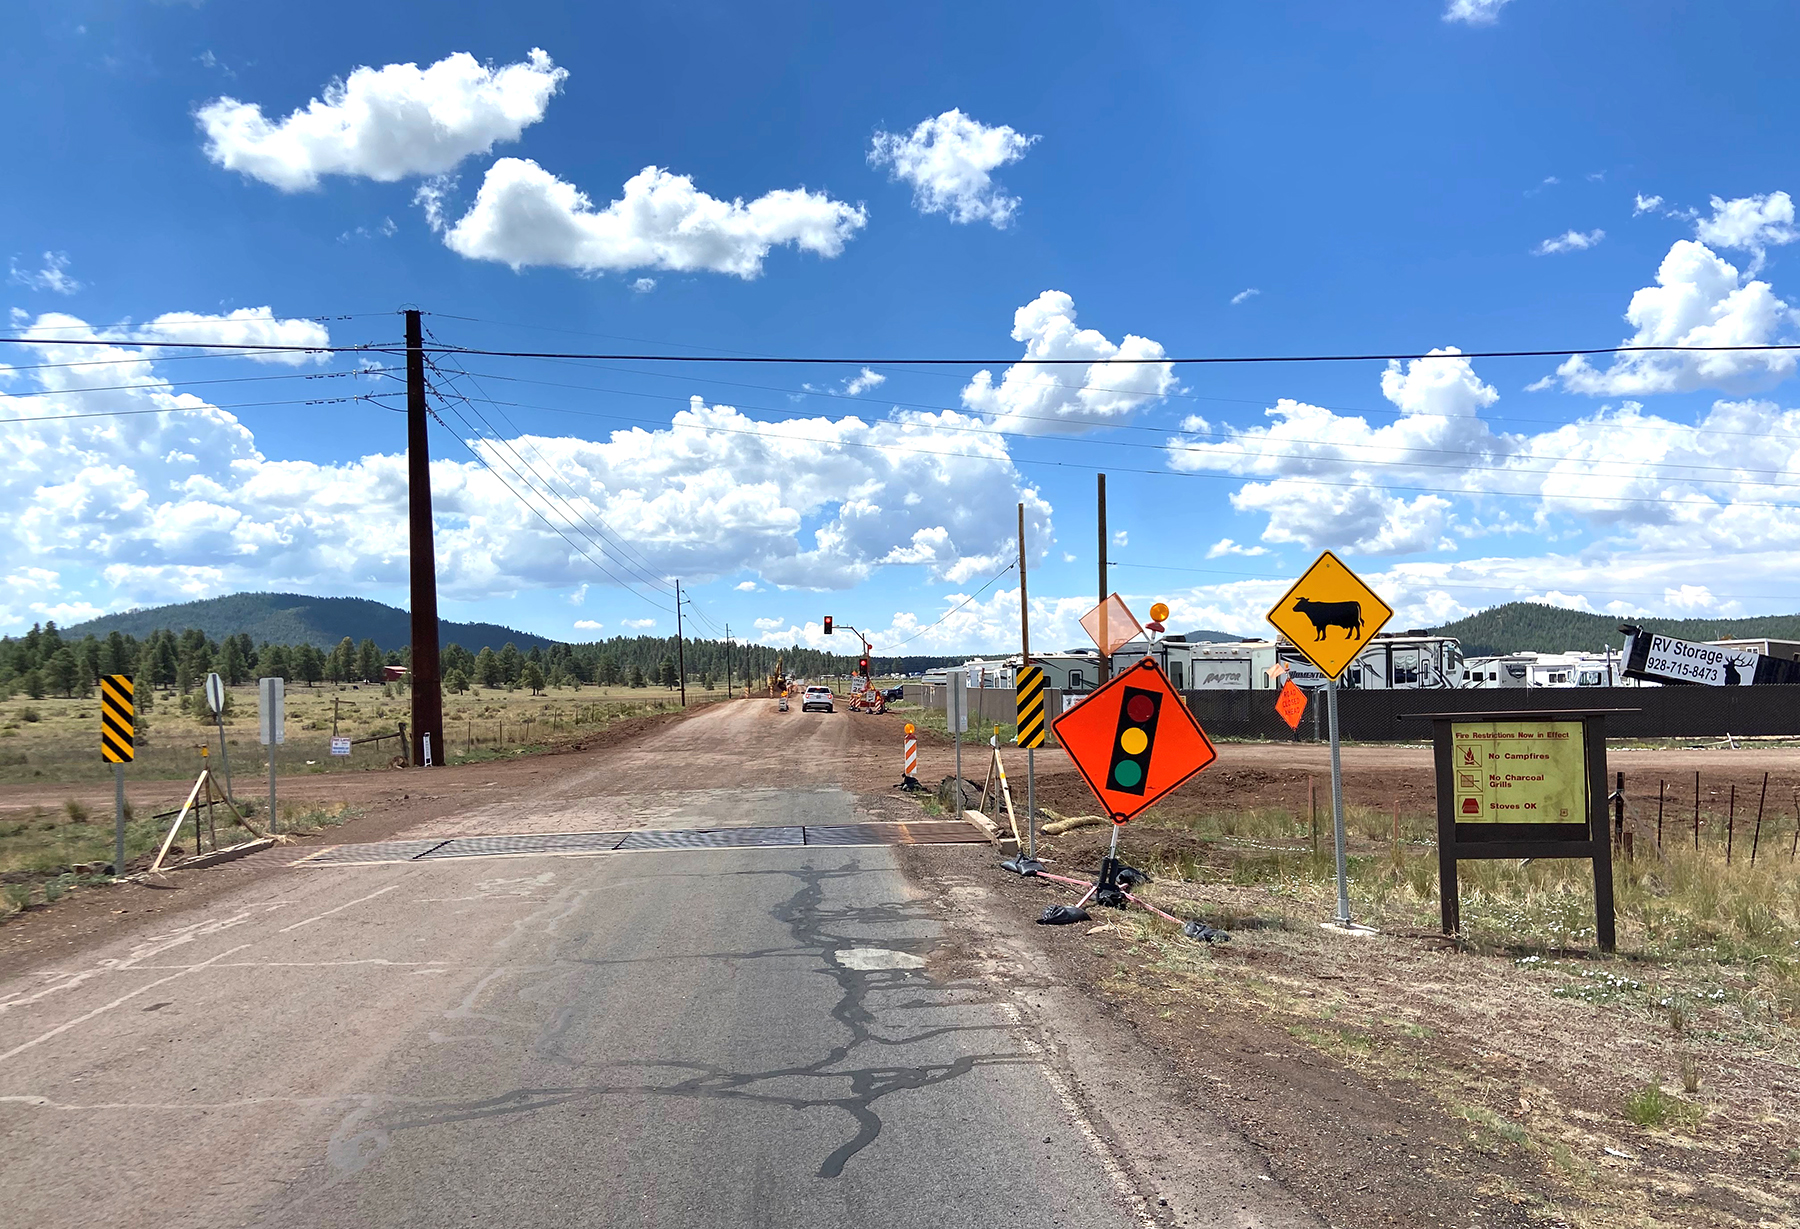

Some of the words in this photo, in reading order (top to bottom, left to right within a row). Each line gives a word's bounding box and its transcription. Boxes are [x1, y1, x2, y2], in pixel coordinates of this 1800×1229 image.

[1652, 637, 1672, 653] RV
[1673, 641, 1723, 665] Storage
[1647, 657, 1718, 681] 928-715-8473
[1203, 672, 1241, 685] RAPTOR
[1284, 689, 1296, 697] ROAD
[1282, 697, 1300, 708] CLOSED
[1284, 706, 1300, 715] AHEAD
[1490, 802, 1520, 810] Stoves
